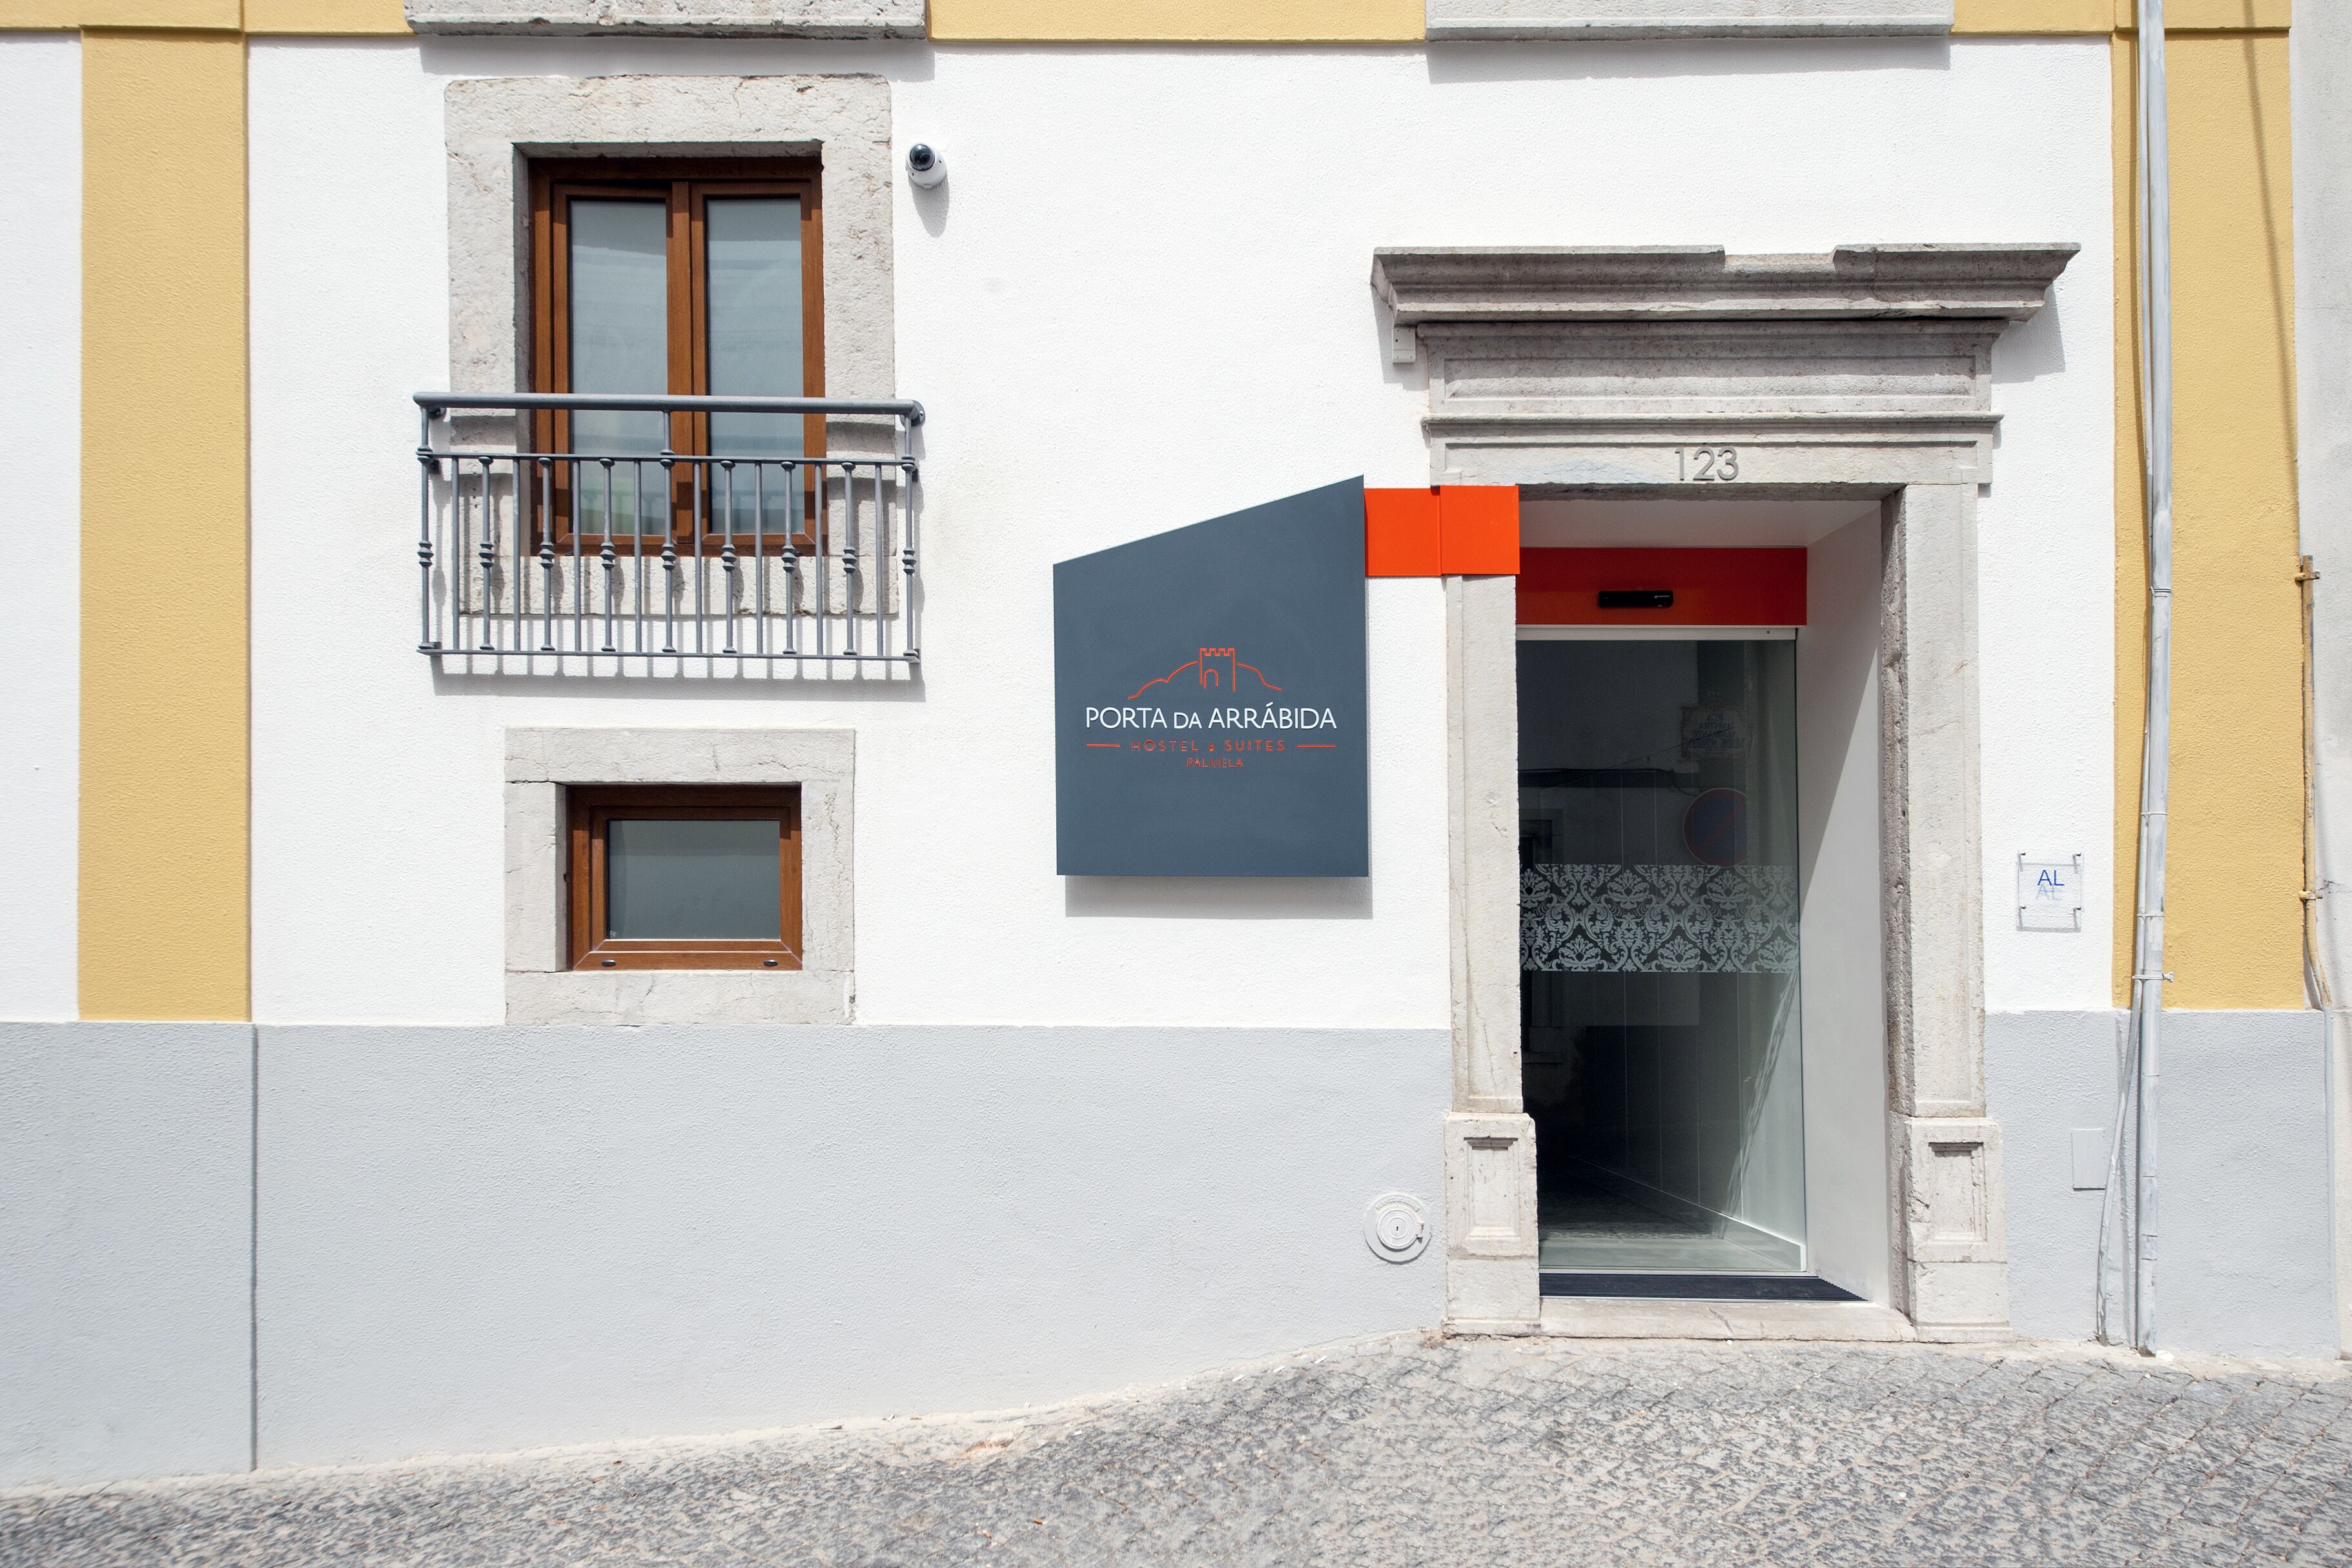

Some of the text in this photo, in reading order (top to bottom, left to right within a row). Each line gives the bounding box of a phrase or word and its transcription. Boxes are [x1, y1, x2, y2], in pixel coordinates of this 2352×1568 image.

[1675, 446, 1739, 481] 123
[1086, 702, 1337, 729] PORTA DA ARRÁBIDA
[1131, 739, 1199, 752] HOSTEL
[1224, 739, 1285, 751] SUITES
[1187, 757, 1243, 768] PALMELA
[2037, 870, 2065, 886] AL
